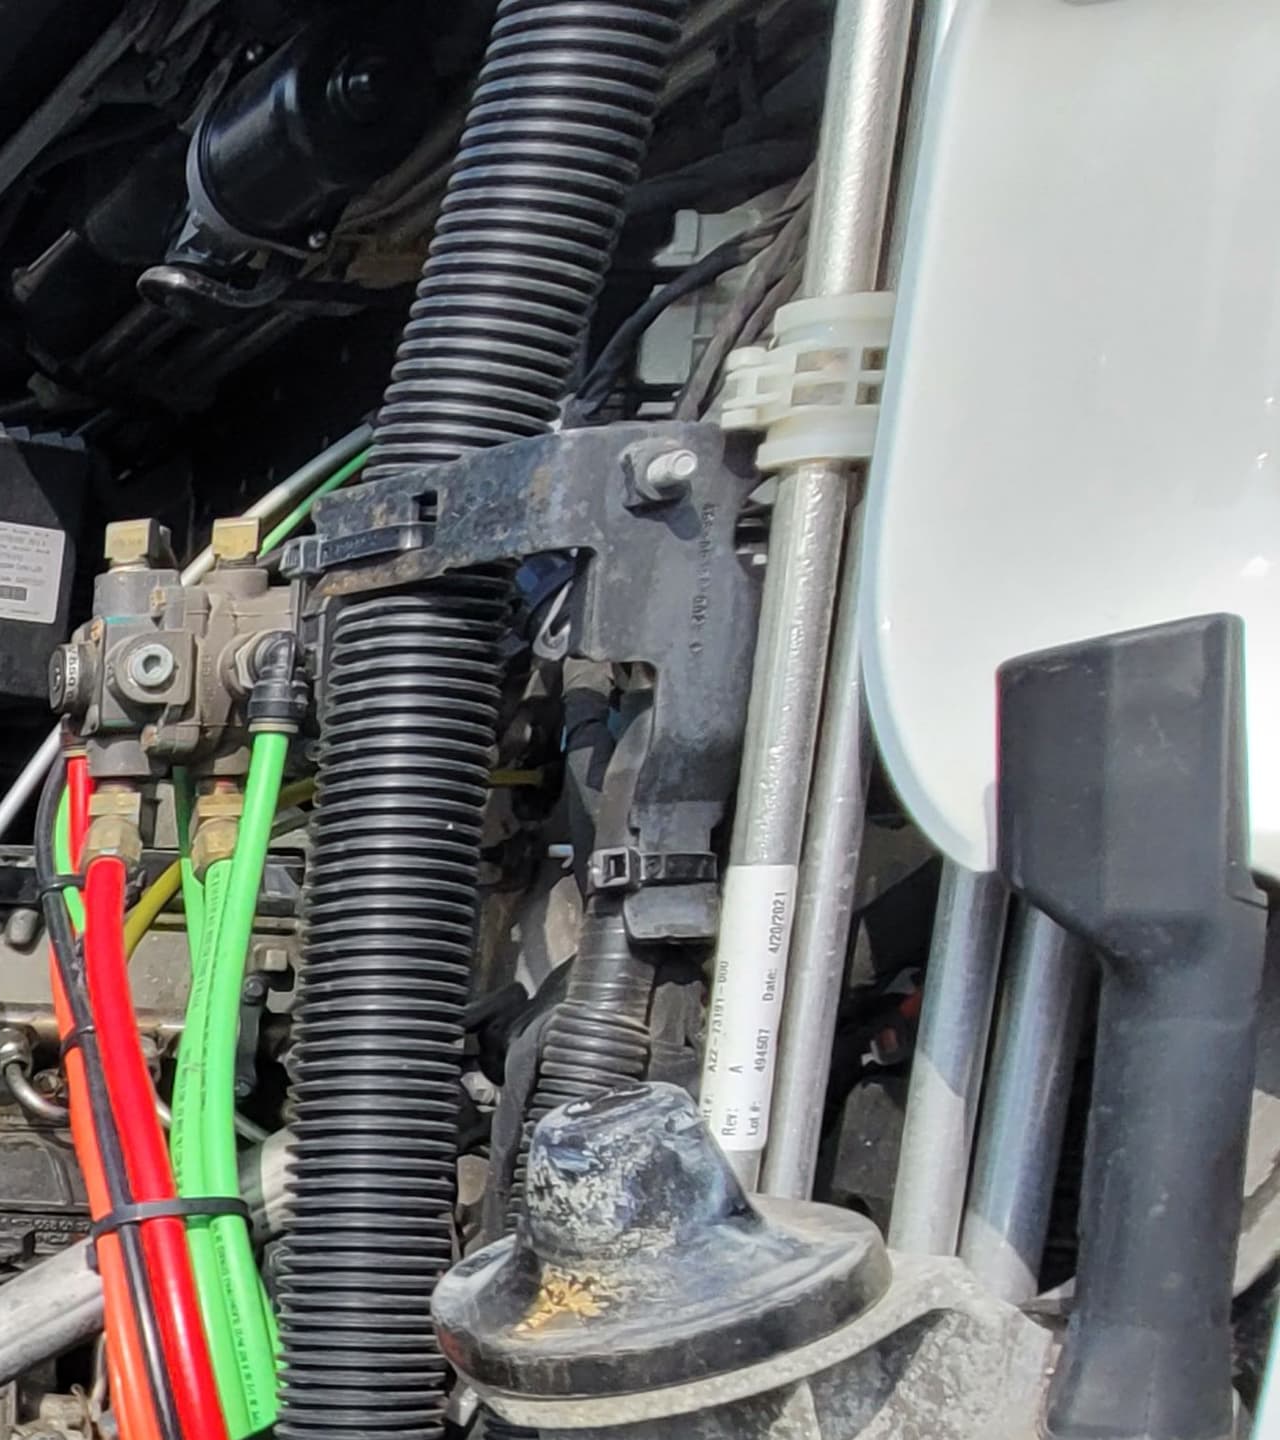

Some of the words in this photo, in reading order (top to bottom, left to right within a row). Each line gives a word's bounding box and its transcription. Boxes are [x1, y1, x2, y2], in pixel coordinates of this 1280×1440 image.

[746, 1110, 760, 1137] Lot
[762, 967, 778, 1003] Date:
[729, 1064, 743, 1075] A
[721, 1107, 738, 1137] Rev:
